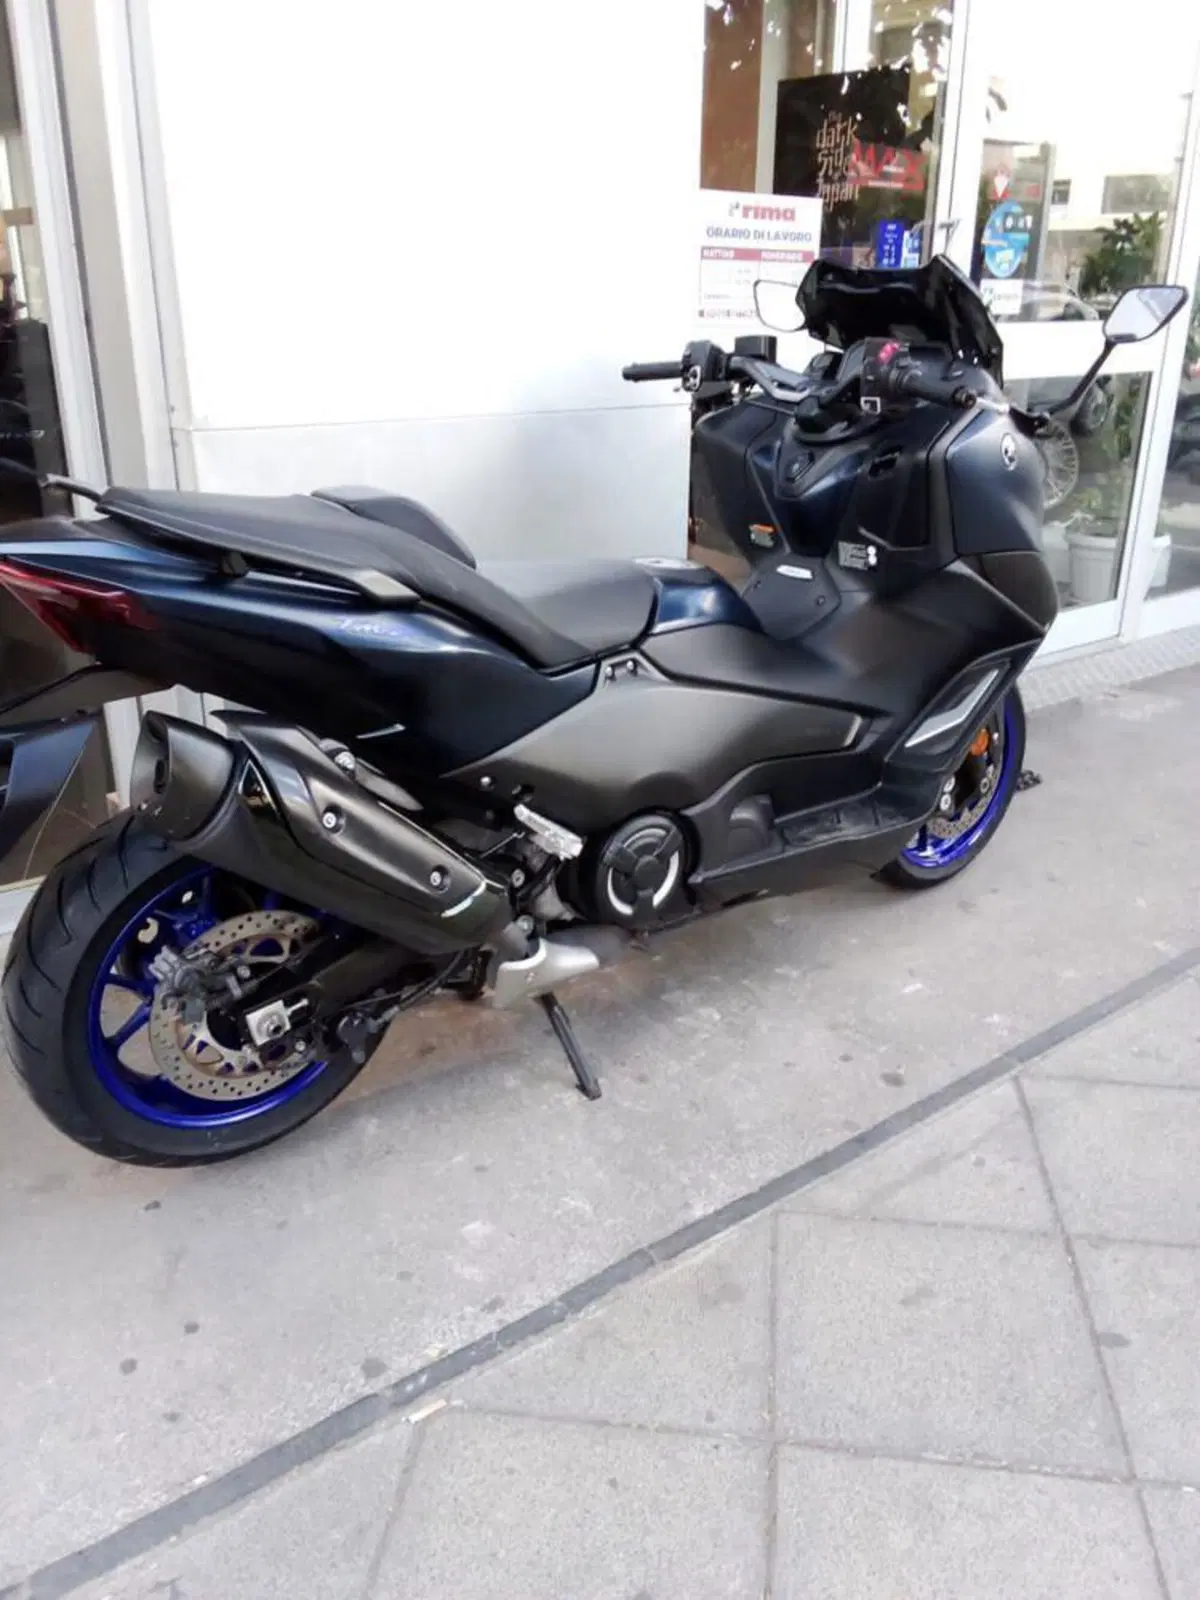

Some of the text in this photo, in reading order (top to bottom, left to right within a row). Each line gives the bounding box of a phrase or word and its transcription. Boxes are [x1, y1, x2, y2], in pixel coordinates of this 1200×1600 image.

[816, 116, 858, 149] dark
[706, 225, 812, 243] ORARIO DI LAVORO
